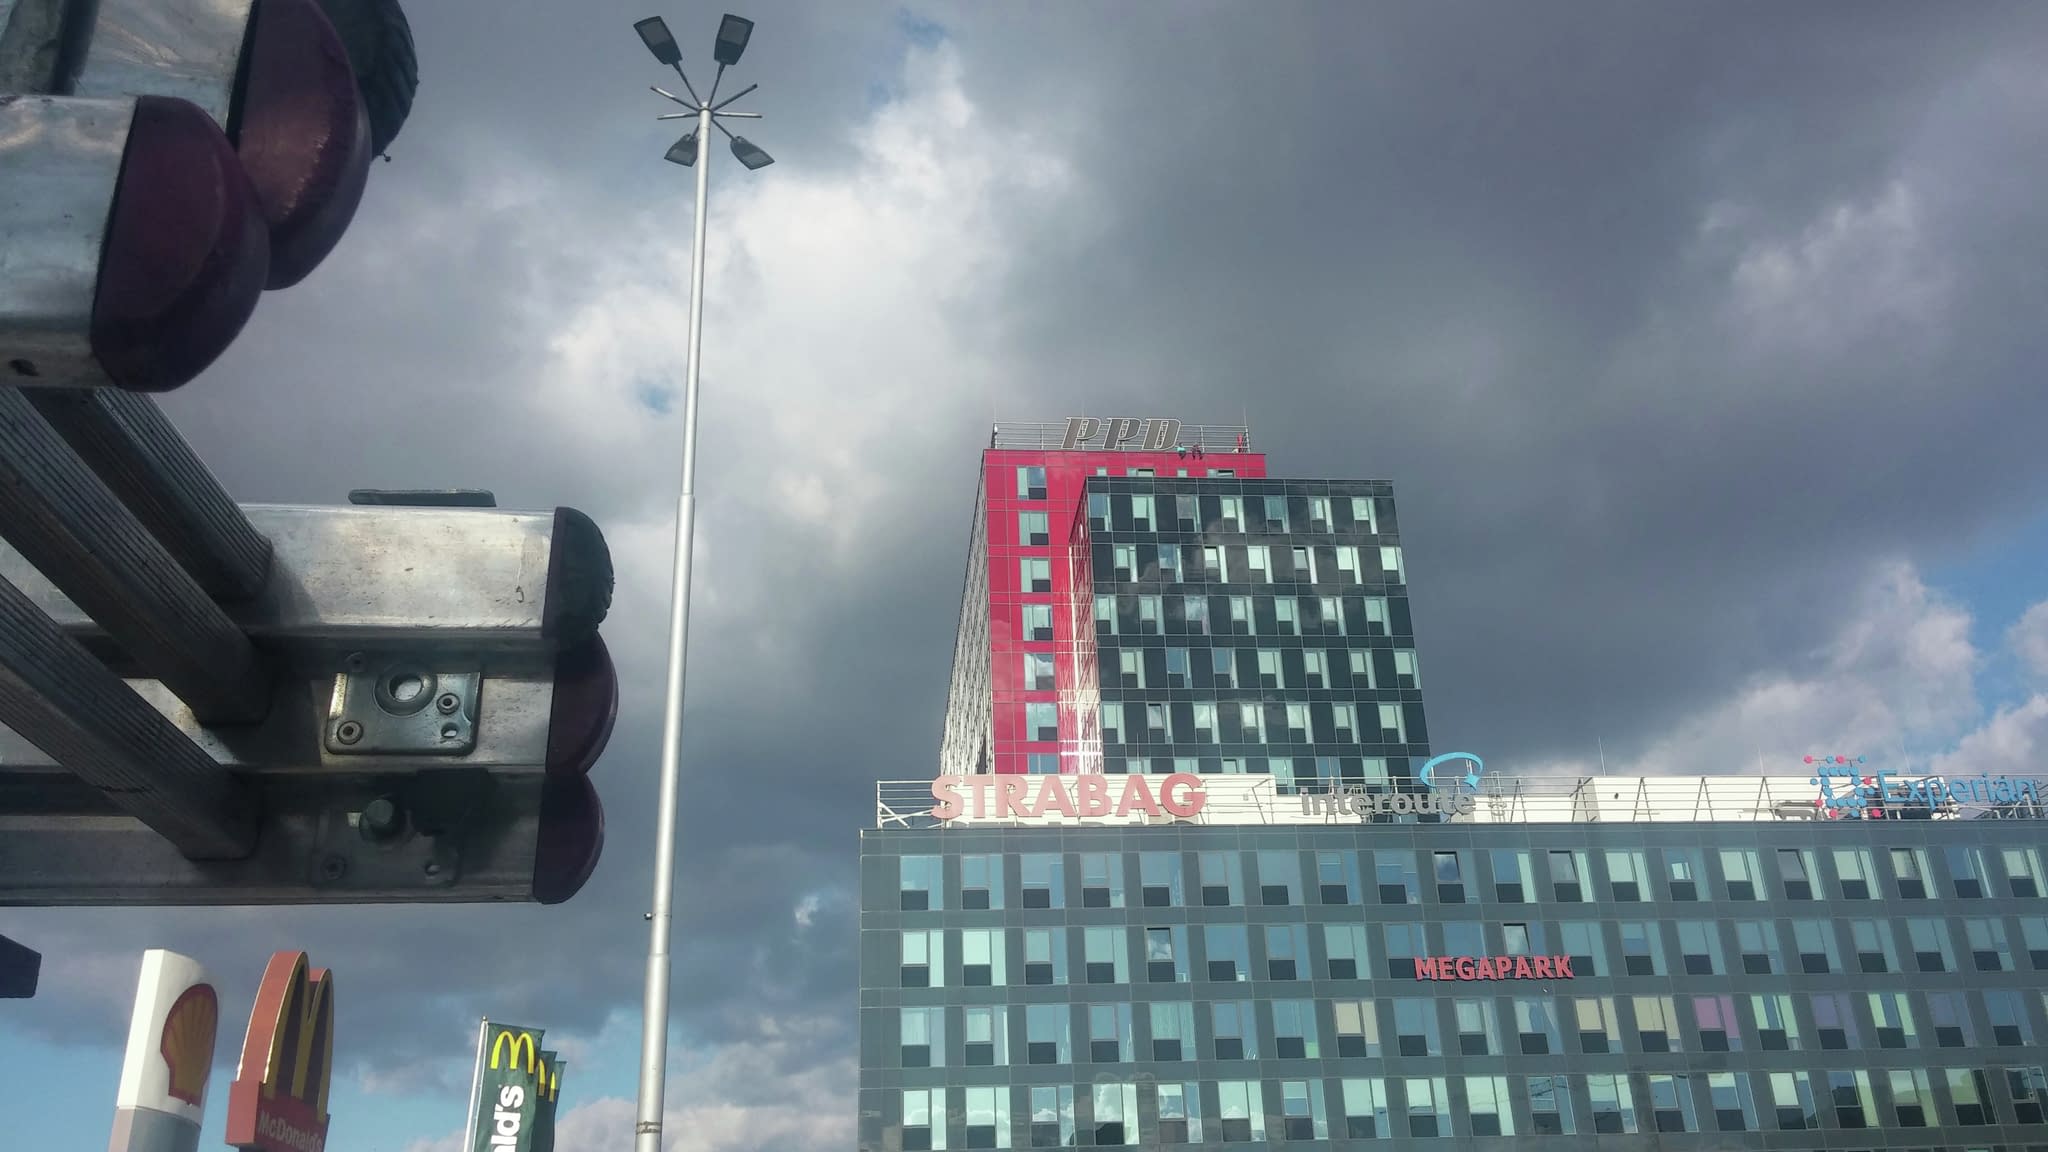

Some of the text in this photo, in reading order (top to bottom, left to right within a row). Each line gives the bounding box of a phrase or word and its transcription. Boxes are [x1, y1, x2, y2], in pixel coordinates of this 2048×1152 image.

[1061, 417, 1181, 450] PPD
[931, 773, 1206, 819] STRABAG
[1300, 786, 1476, 816] interoute
[1877, 770, 2037, 811] Experian
[1414, 955, 1574, 981] MEGAPARK
